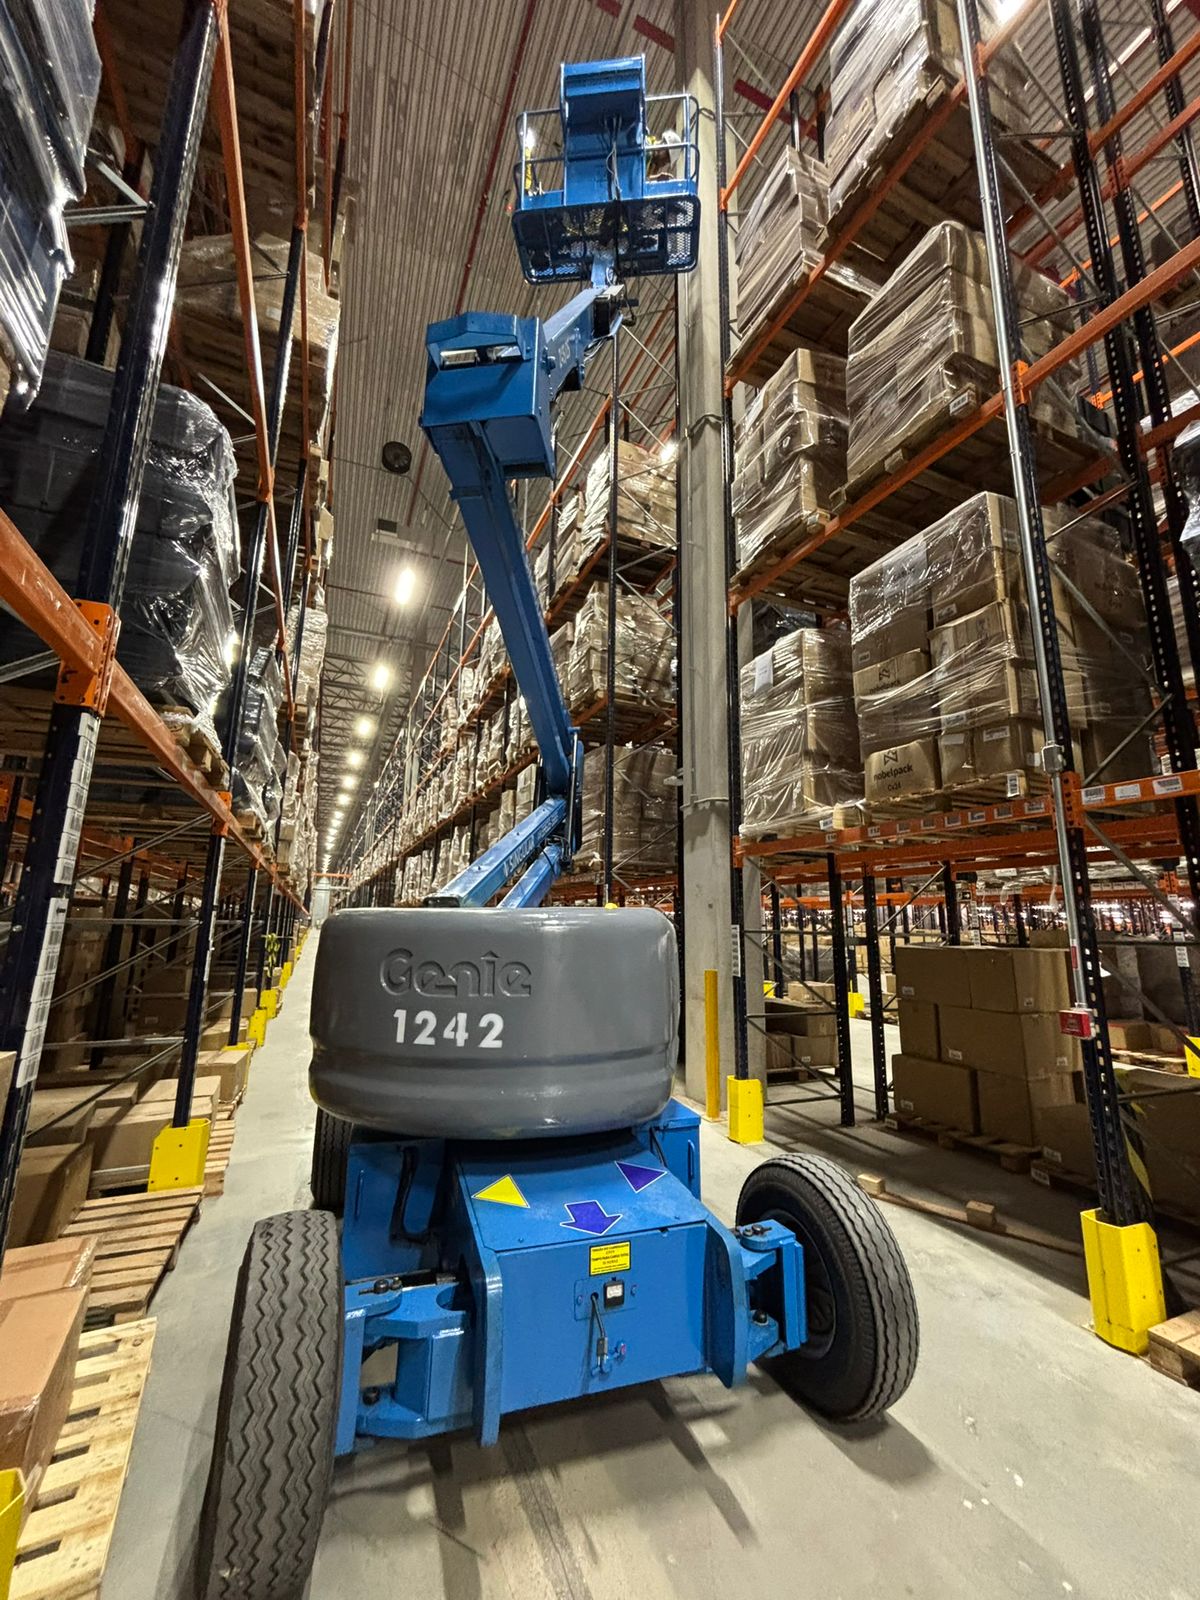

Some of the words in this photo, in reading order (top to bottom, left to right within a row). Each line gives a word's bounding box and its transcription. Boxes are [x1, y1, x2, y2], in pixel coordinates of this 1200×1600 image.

[873, 763, 913, 781] nobelpack
[380, 948, 532, 998] Genie
[393, 1009, 505, 1048] 1242
